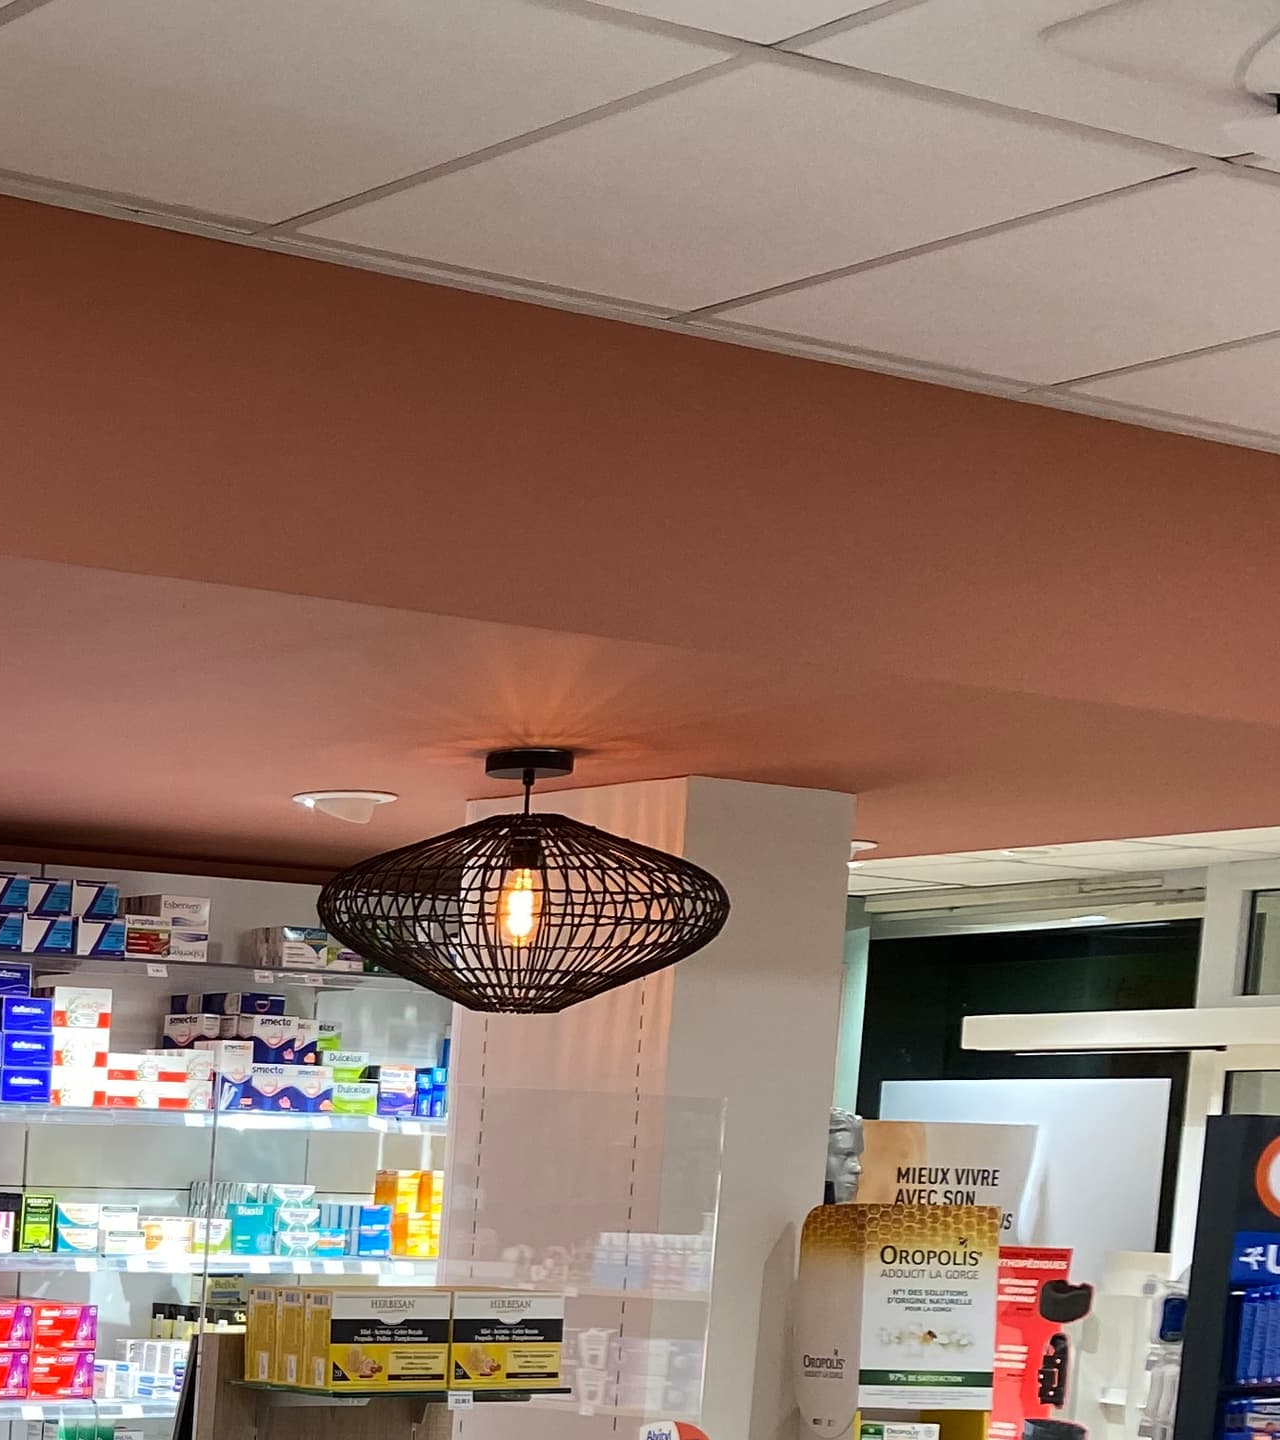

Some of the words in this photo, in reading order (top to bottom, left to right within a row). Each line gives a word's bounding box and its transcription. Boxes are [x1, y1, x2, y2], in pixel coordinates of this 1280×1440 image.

[169, 1016, 198, 1024] smecta
[260, 1017, 291, 1026] smecta
[252, 1065, 284, 1074] smecta
[897, 1167, 952, 1185] MIEUX
[956, 1169, 999, 1186] VIVRE
[895, 1190, 940, 1206] AVEC
[944, 1191, 976, 1206] SON
[880, 1269, 925, 1278] ADOUCIT
[930, 1270, 942, 1278] LA
[945, 1270, 979, 1280] GORGE
[925, 1289, 968, 1297] SOLUTIONS
[371, 1300, 414, 1310] HERBESAN
[490, 1300, 531, 1310] HERBESAN
